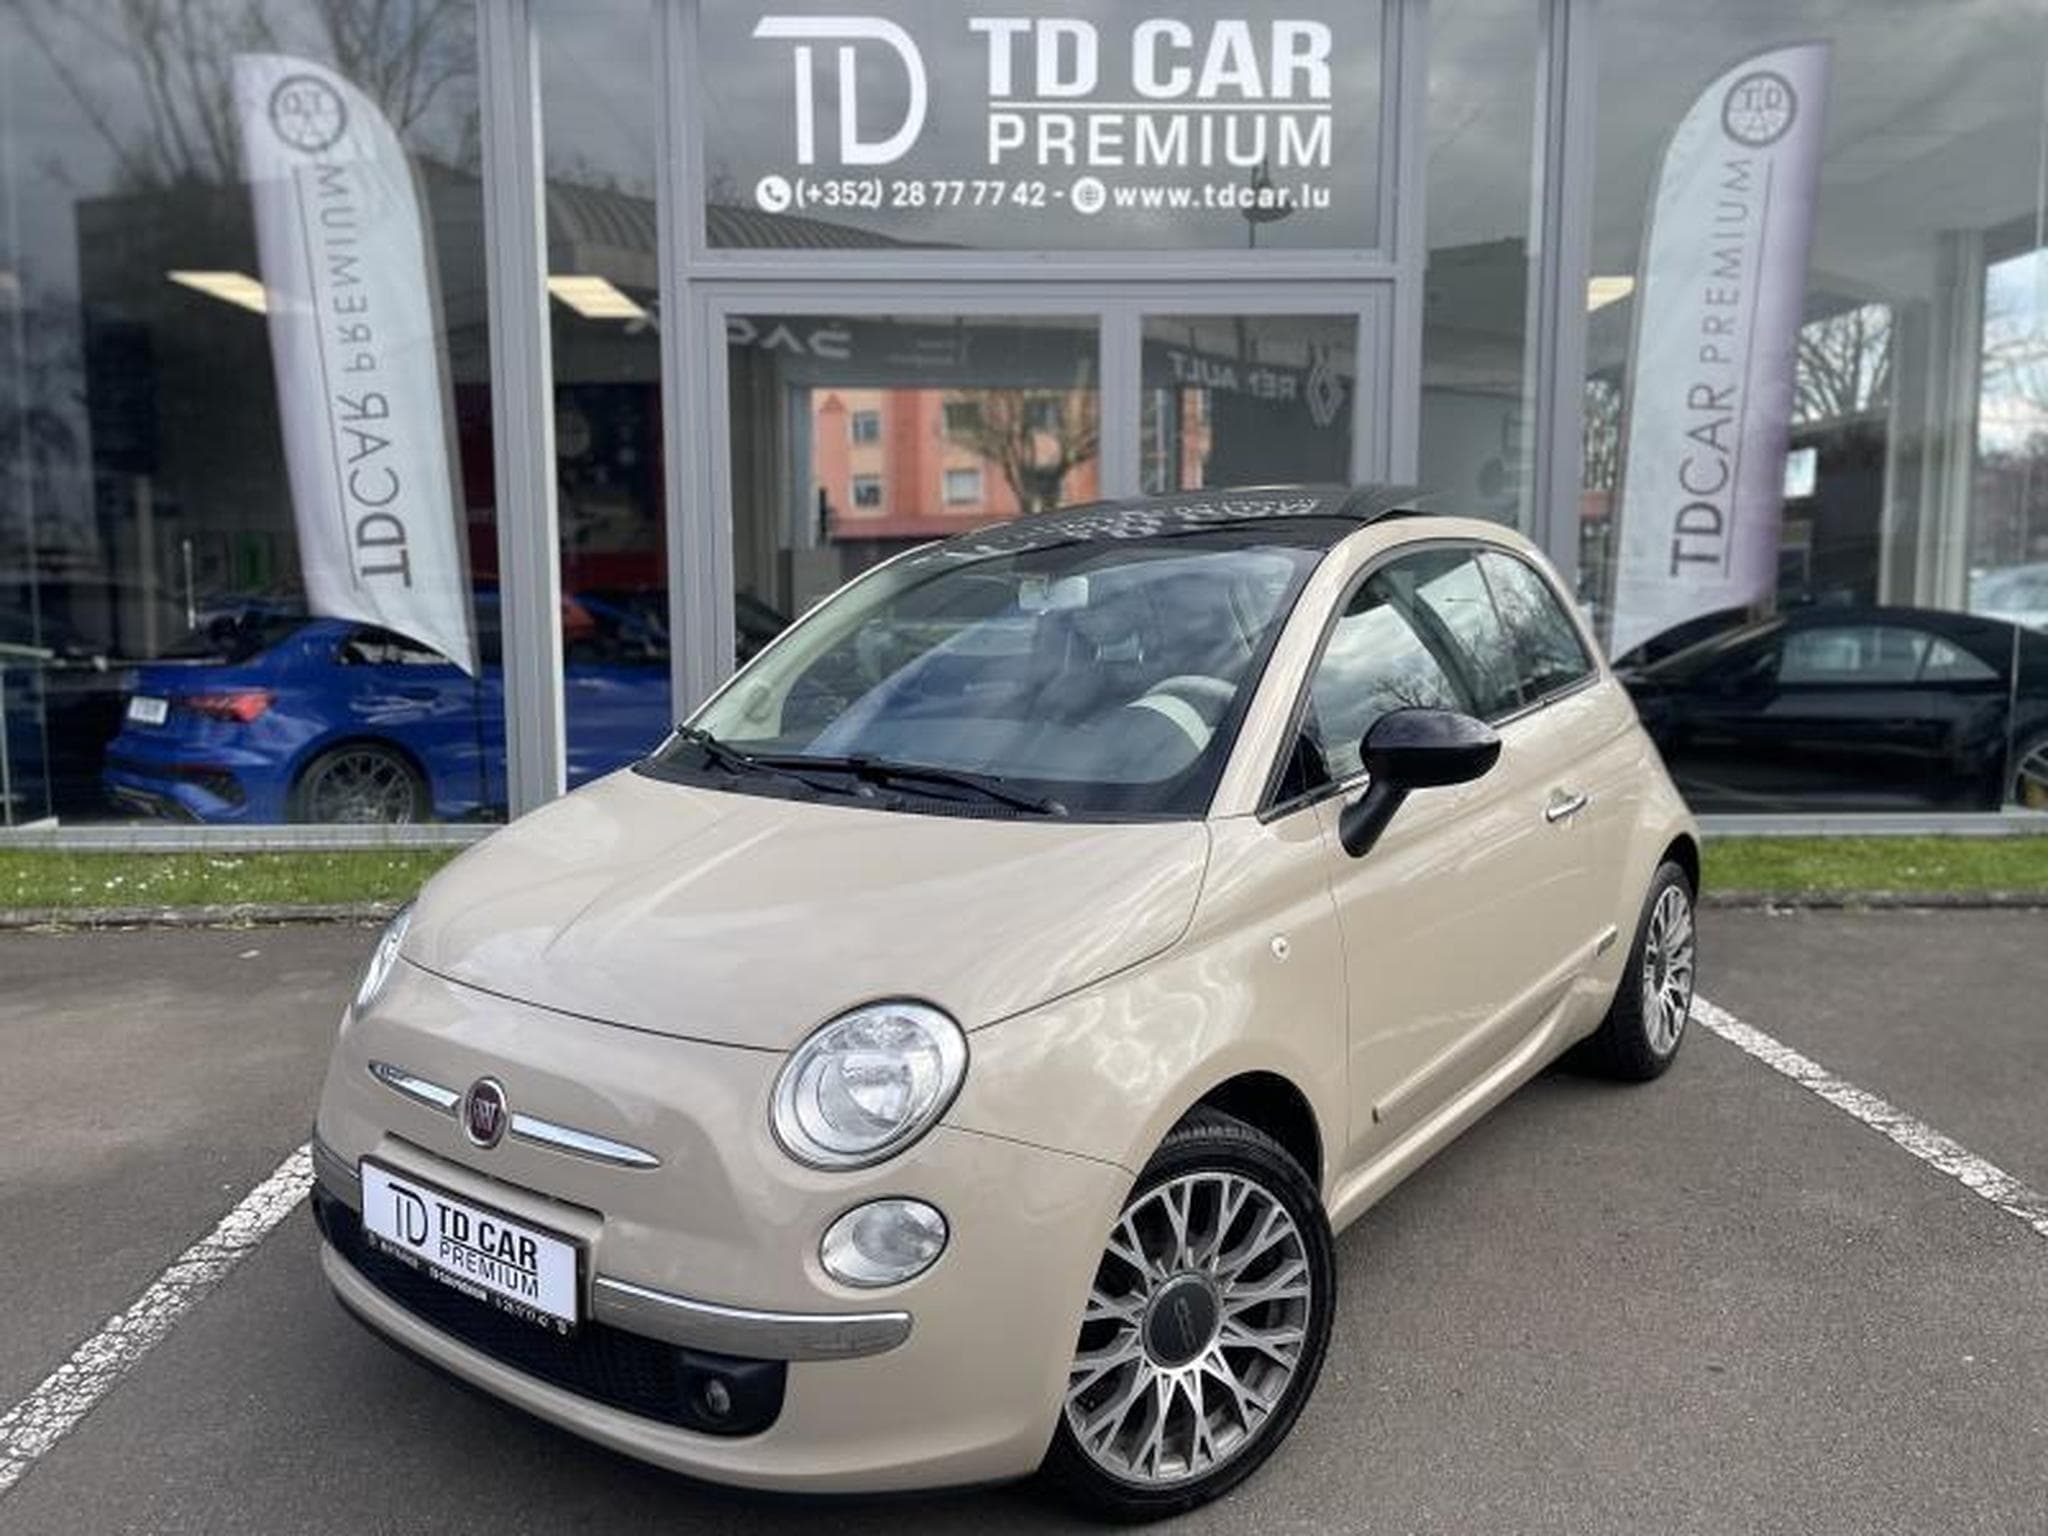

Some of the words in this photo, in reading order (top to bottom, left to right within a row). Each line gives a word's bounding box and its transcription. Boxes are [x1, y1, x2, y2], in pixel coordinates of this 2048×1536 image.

[969, 17, 1099, 97] TD
[1132, 18, 1332, 99] CAR
[989, 113, 1332, 167] PREMIUM
[796, 178, 883, 208] (+352)
[892, 180, 926, 206] 28
[932, 180, 965, 206] 77
[972, 180, 1006, 206] 77
[1011, 181, 1046, 207] 42
[1113, 183, 1330, 208] www.tdcar.lu
[1700, 158, 1751, 364] PREMIUM
[1669, 383, 1738, 578] TDCAR
[435, 1202, 470, 1247] TD
[478, 1221, 538, 1271] CAR
[439, 1241, 539, 1300] PREMIUM
